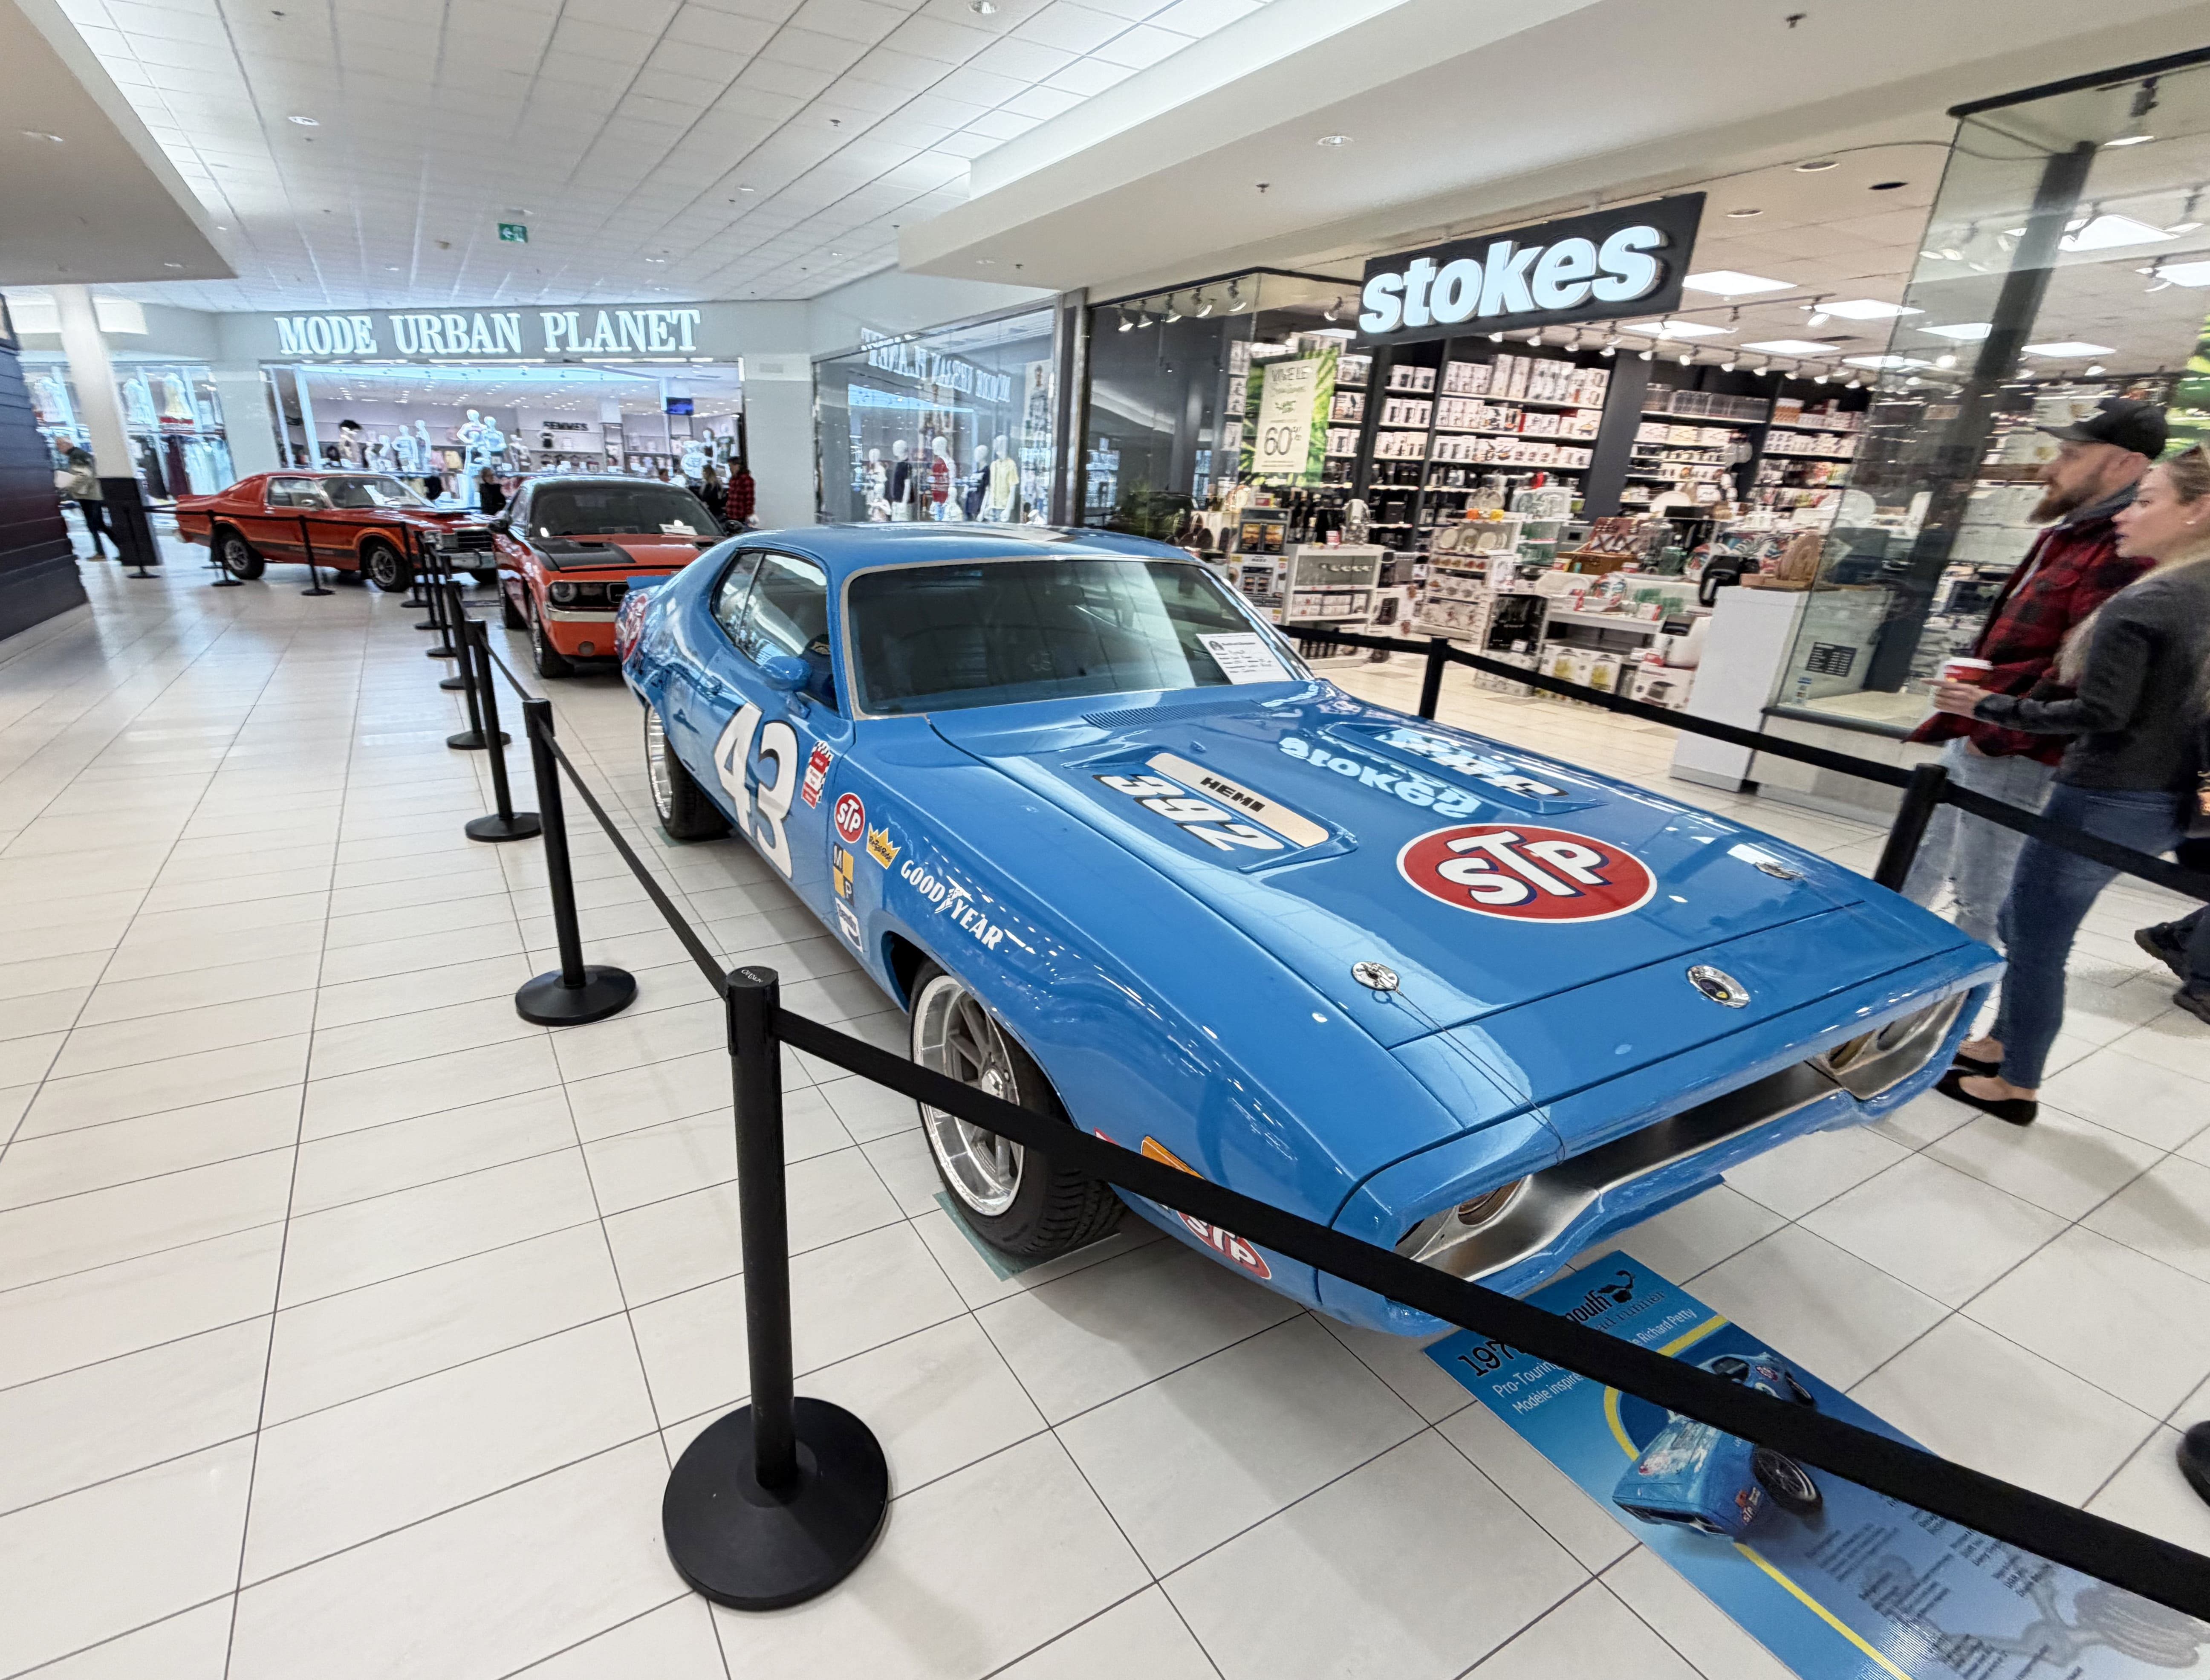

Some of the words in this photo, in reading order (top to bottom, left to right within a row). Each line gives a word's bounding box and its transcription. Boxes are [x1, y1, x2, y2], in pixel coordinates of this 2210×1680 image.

[1358, 225, 1666, 334] stokes
[274, 315, 377, 355] MODE
[389, 312, 521, 354] URBAN
[540, 309, 700, 353] PLANET
[714, 703, 797, 878] 43
[837, 798, 861, 833] STP
[1092, 773, 1285, 851] 392
[1200, 777, 1266, 813] HEMI
[1436, 830, 1609, 905] STP
[1458, 1340, 1514, 1376] 197
[1511, 1389, 1553, 1416] Modèle
[1636, 1319, 1674, 1343] Richard
[1666, 1308, 1698, 1326] Petty
